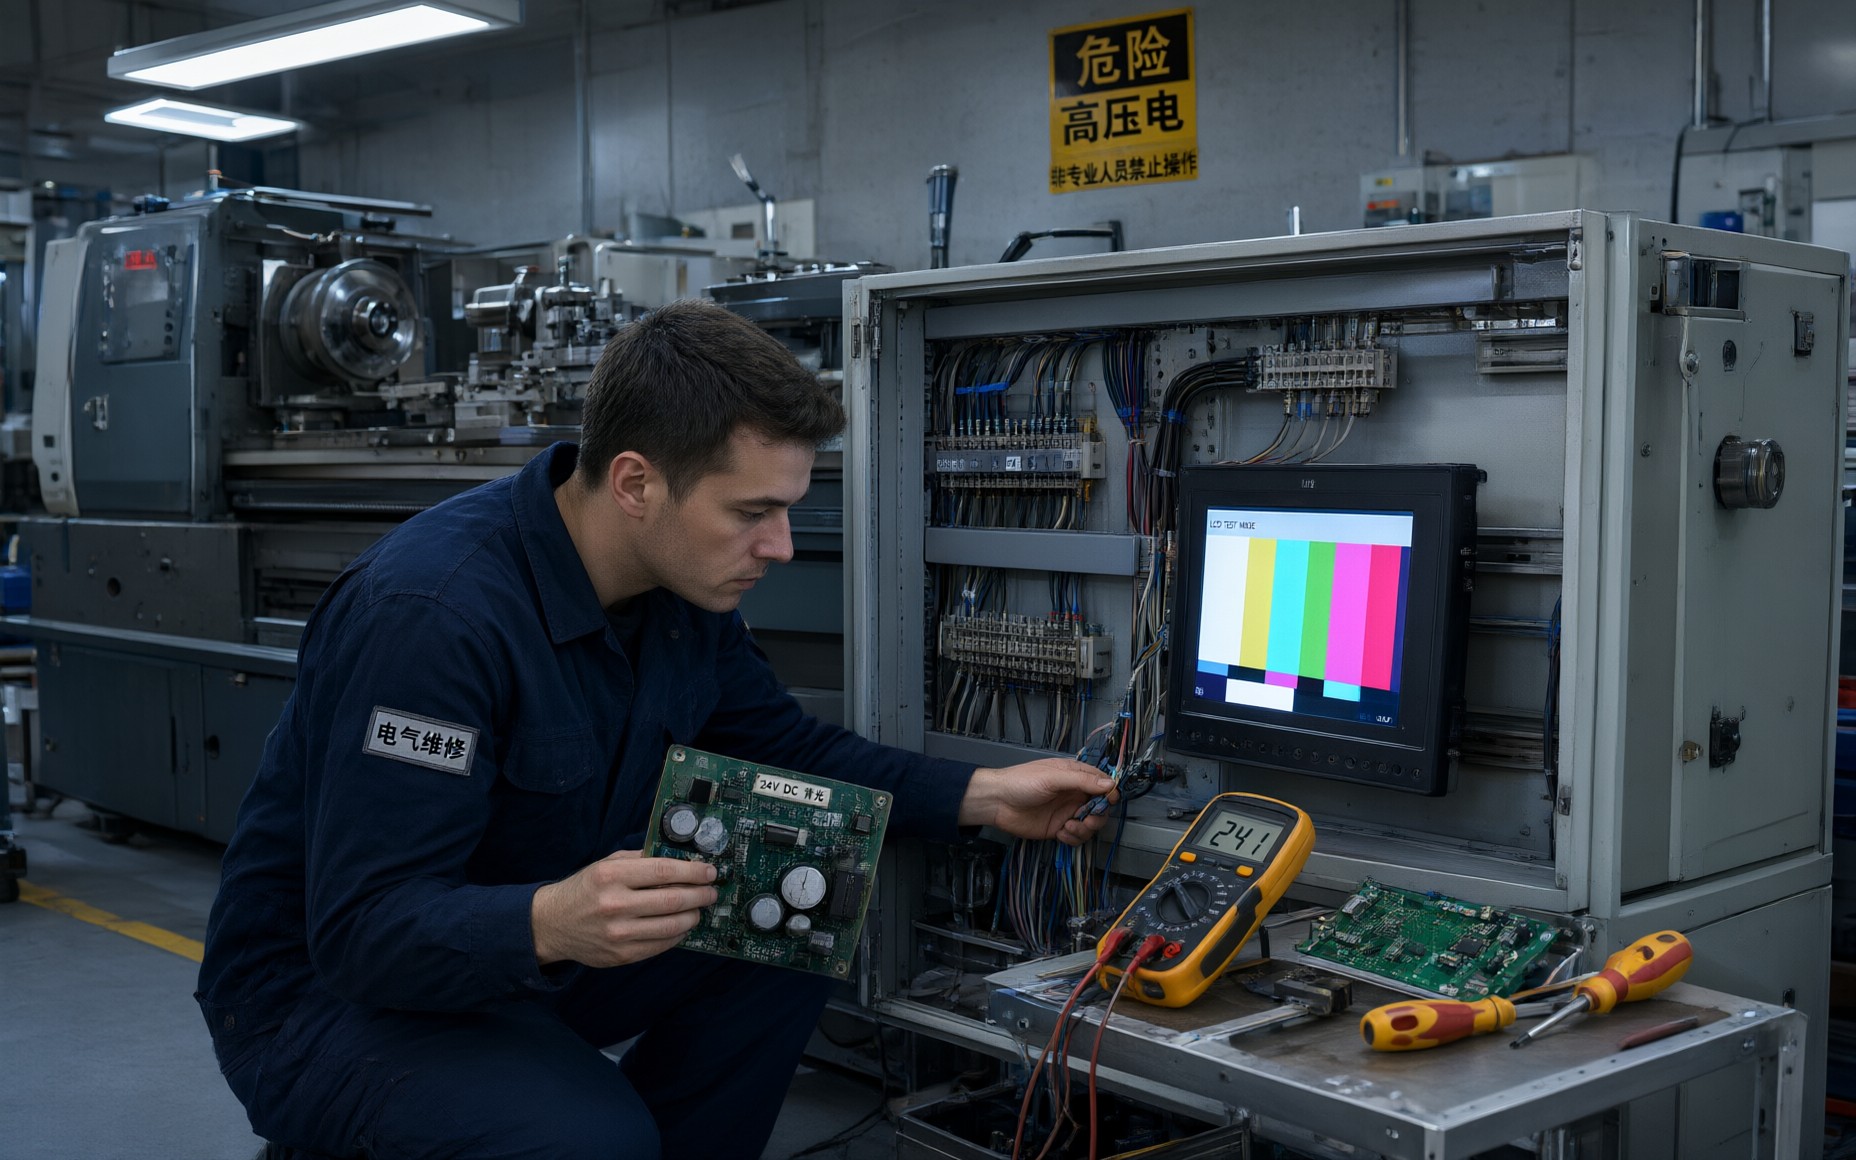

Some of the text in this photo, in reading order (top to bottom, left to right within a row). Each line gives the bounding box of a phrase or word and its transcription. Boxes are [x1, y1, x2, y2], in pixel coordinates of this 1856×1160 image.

[1076, 25, 1170, 87] 危险
[1060, 89, 1184, 146] 高压电
[1051, 151, 1197, 188] 非专业人员禁止操作
[377, 721, 466, 760] 电气维修
[759, 779, 780, 792] 24V
[783, 783, 799, 796] DC
